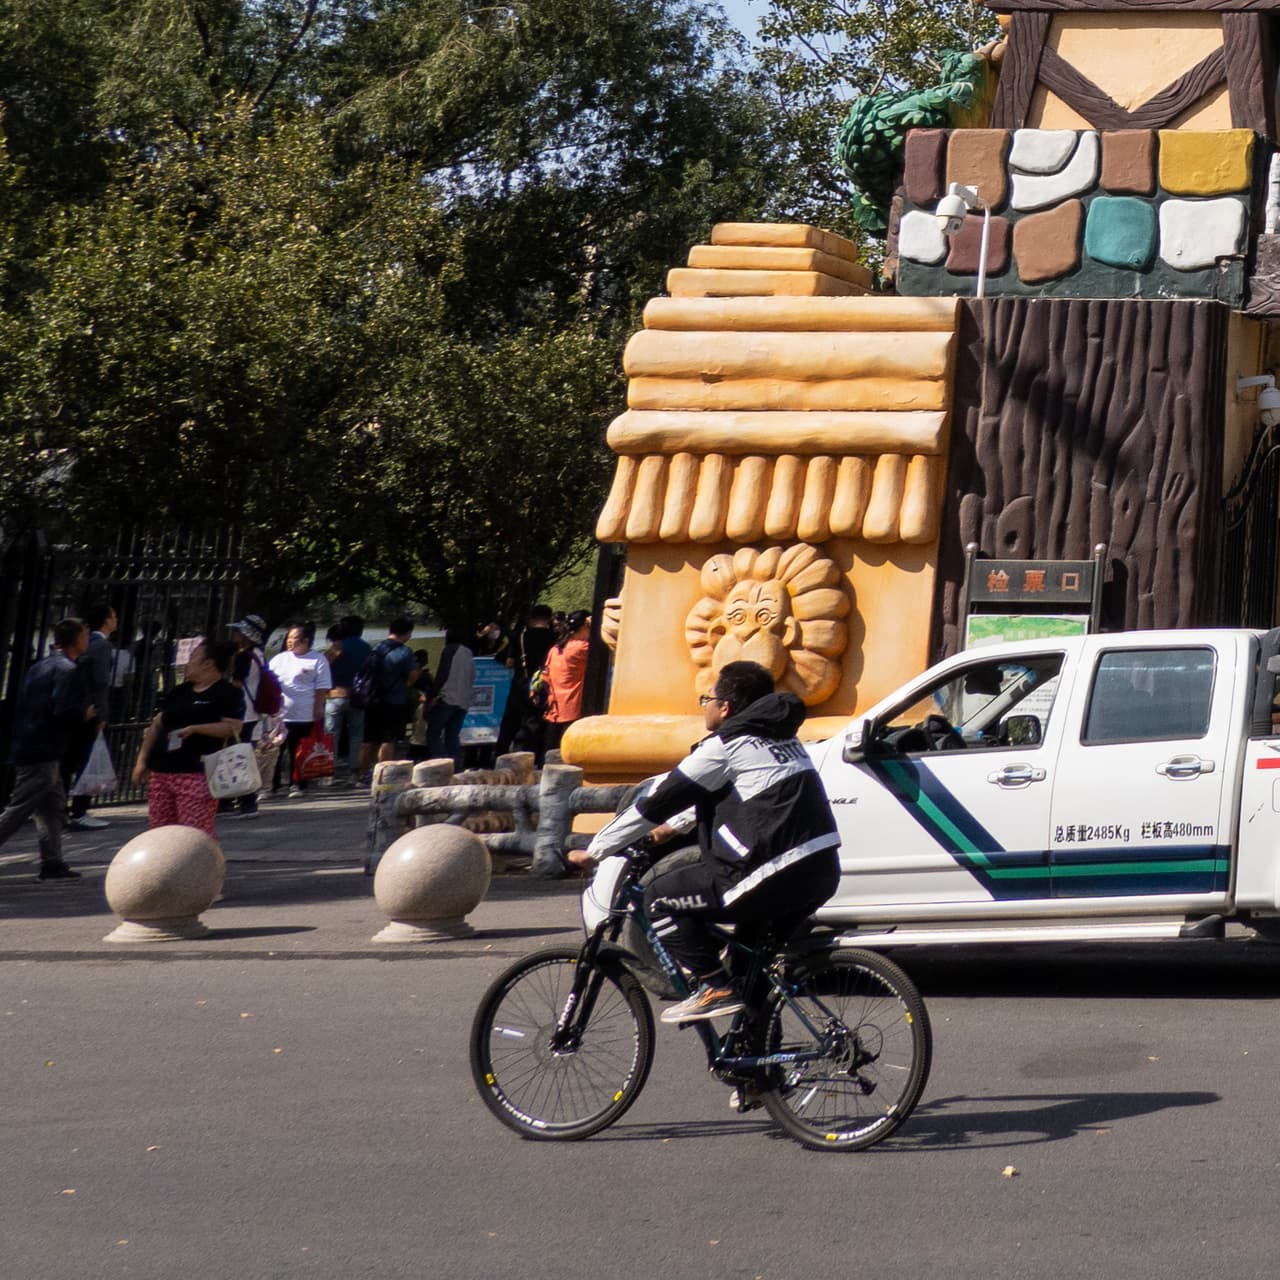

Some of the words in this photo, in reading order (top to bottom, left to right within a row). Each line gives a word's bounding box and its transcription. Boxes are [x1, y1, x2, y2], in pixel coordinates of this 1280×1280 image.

[987, 570, 1080, 592] 检票口
[1054, 823, 1131, 843] 总质量2485Kg
[1141, 821, 1214, 839] 栏板高480mm
